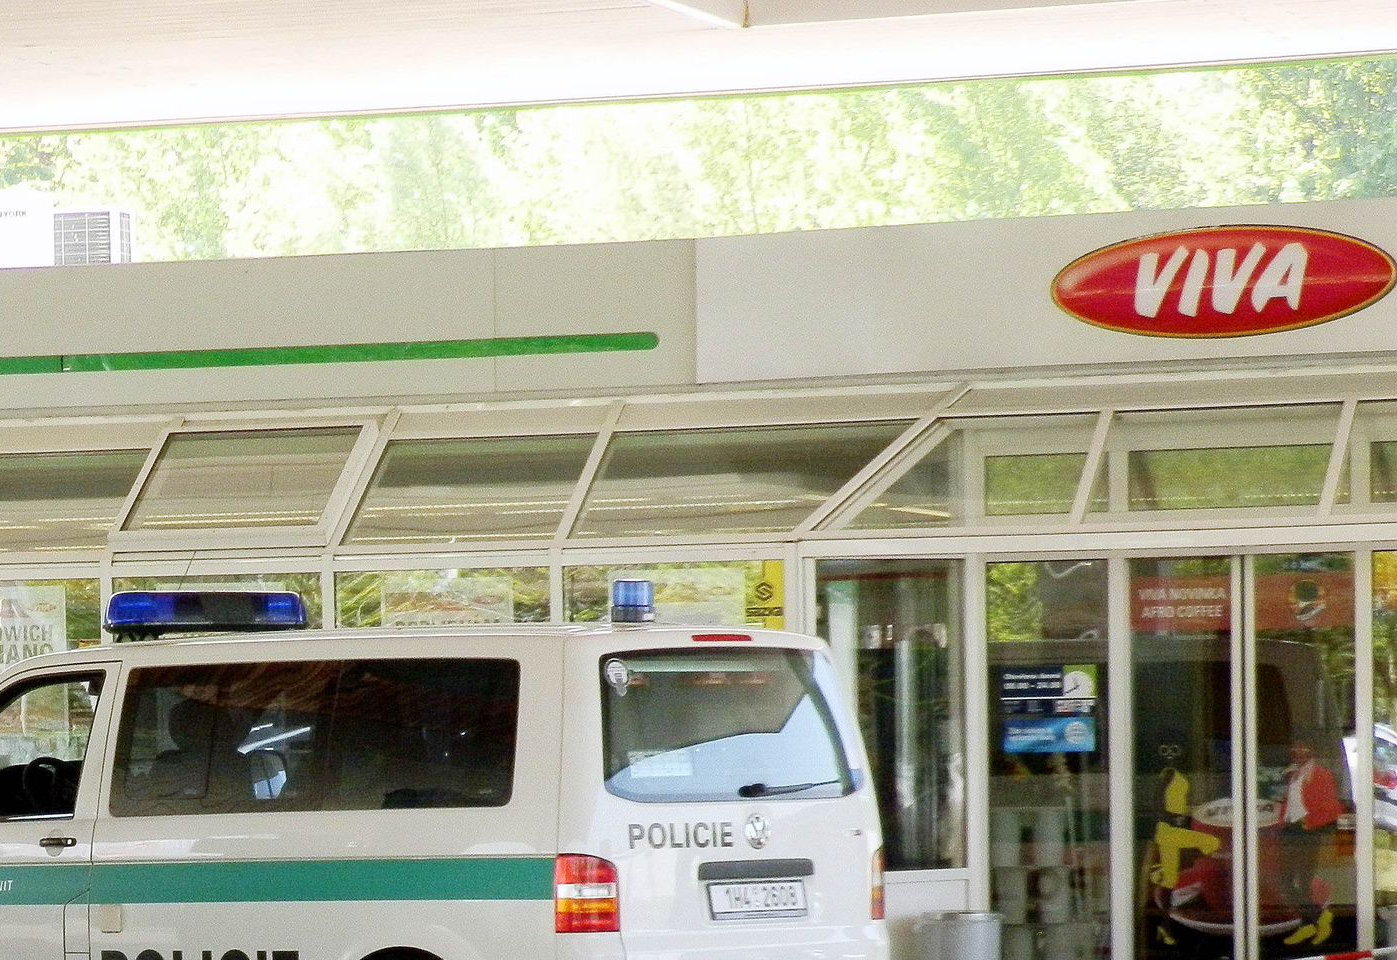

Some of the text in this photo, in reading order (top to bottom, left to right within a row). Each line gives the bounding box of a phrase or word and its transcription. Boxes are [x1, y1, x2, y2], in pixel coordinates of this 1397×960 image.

[1134, 242, 1308, 318] VIVA
[1141, 604, 1223, 618] AFRO COFFEE
[627, 821, 734, 849] POLICIE
